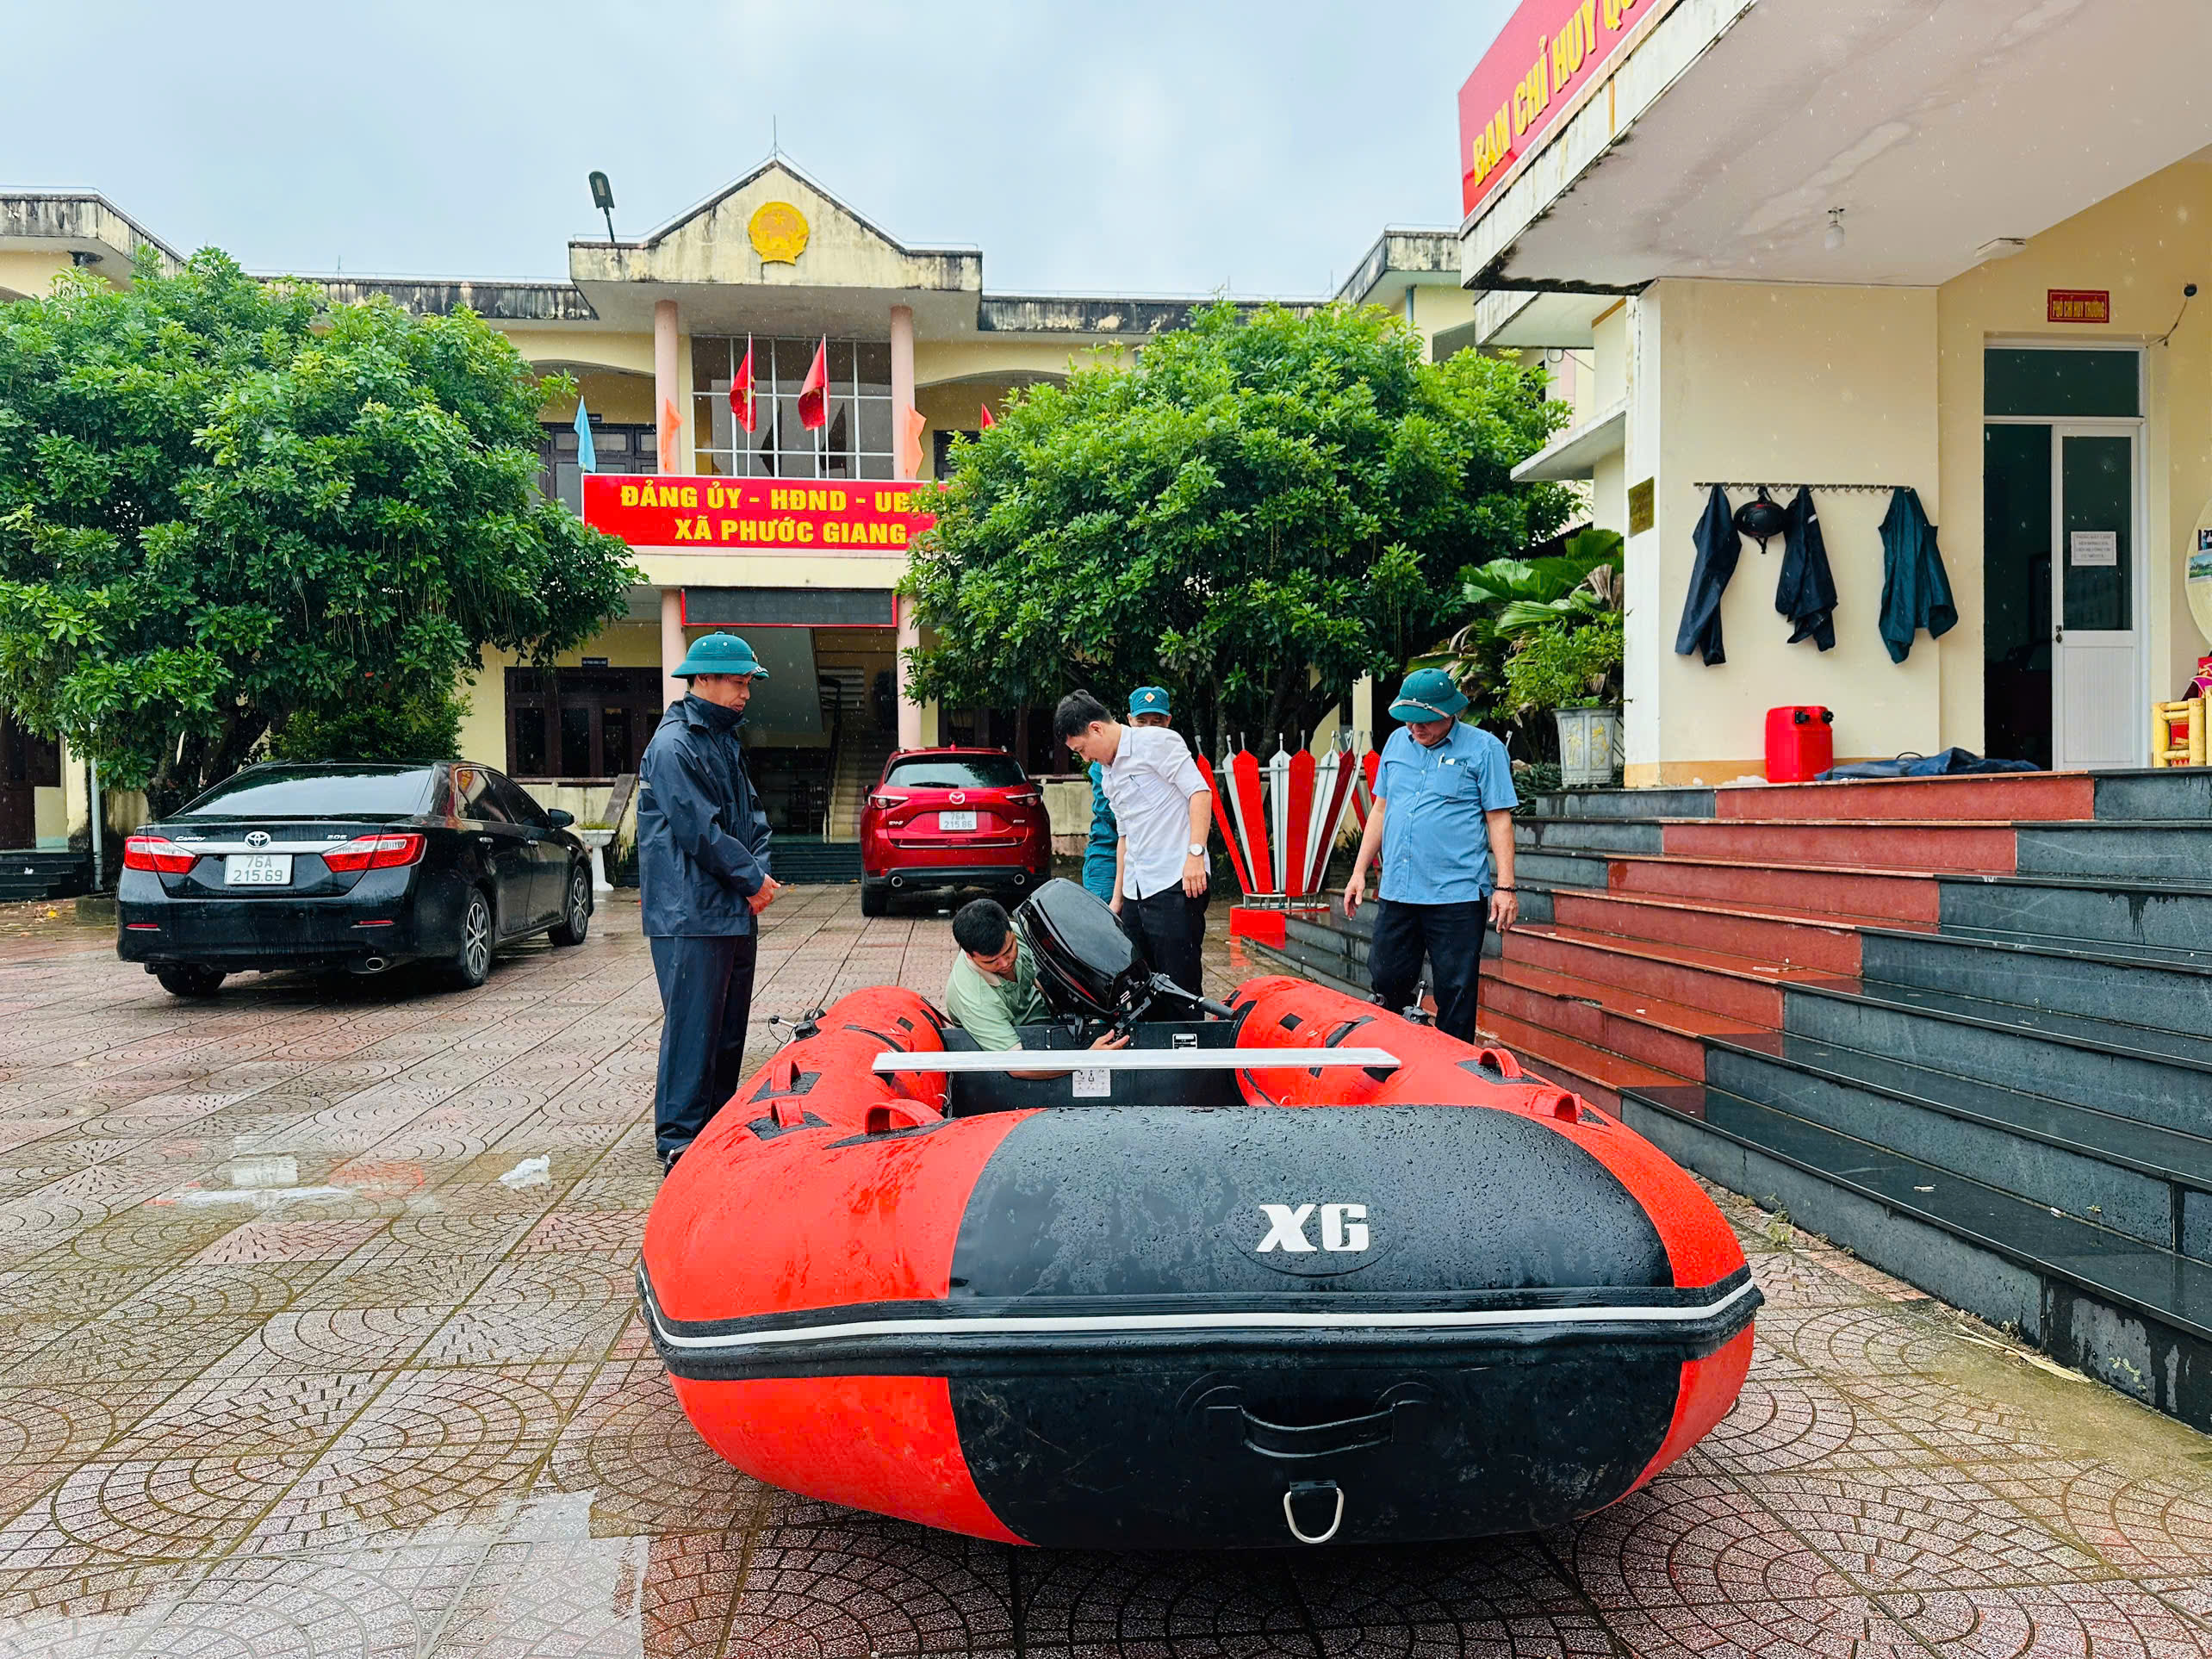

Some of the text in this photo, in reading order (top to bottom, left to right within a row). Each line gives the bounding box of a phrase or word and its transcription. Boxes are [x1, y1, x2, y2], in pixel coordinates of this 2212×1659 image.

[1473, 99, 1512, 187] BAN
[1513, 34, 1550, 136] CHỈ
[1552, 0, 1597, 94] HUY
[620, 479, 698, 508] ĐẢNG
[706, 481, 742, 508] ỦY
[771, 488, 847, 512] HĐND
[674, 515, 906, 544] XÃ PHƯỚC GIANG
[233, 869, 283, 882] 215.69
[246, 855, 272, 868] 76A
[1256, 1203, 1370, 1253] XG
